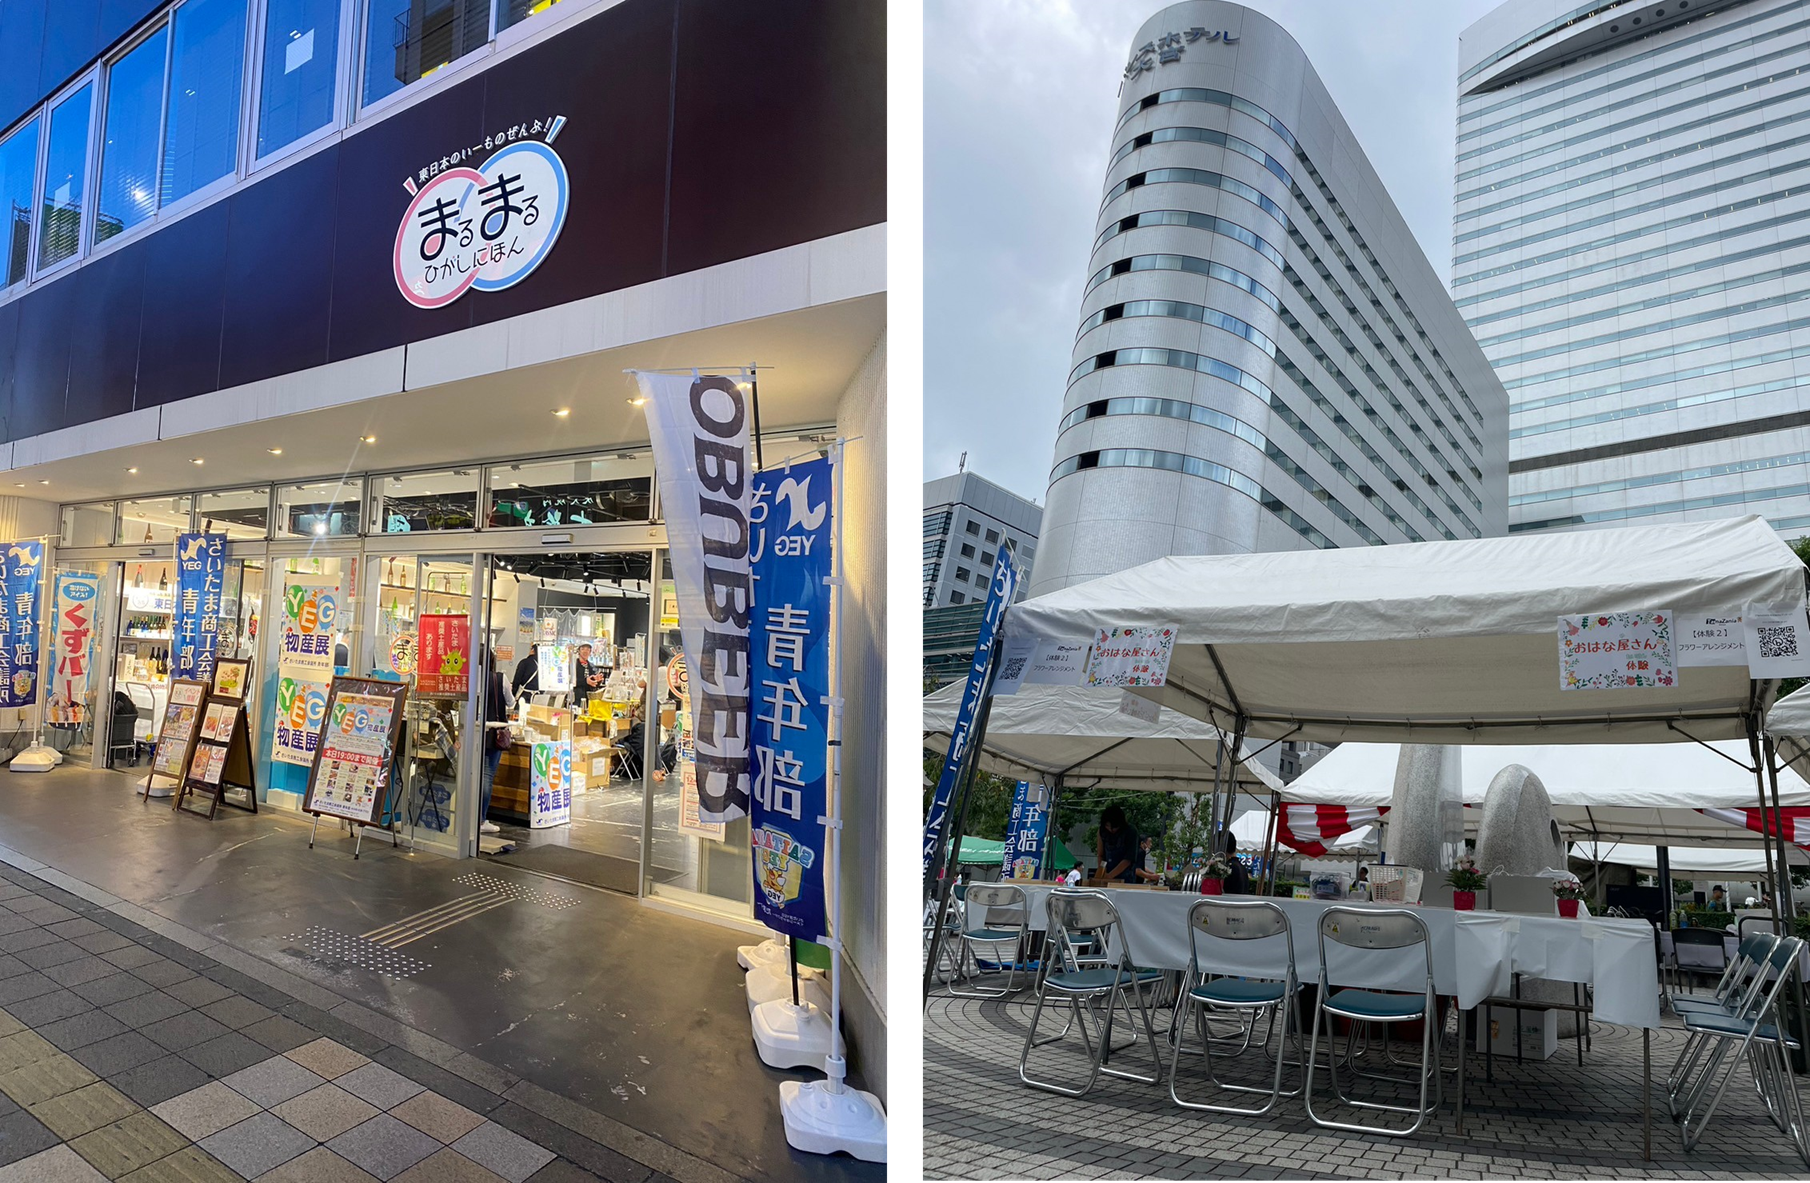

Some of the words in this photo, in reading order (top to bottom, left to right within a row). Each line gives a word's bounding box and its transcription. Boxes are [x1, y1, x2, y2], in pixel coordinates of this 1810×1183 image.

[417, 173, 539, 262] まるまる
[424, 236, 525, 284] ひがしにほん
[182, 561, 202, 570] YEG
[288, 591, 335, 628] YEG
[180, 588, 200, 670] 青年部
[451, 619, 459, 648] さいたま
[58, 602, 90, 703] くずバー
[285, 632, 330, 656] 物産展
[425, 633, 433, 661] あります
[1100, 647, 1160, 658] おはな屋さん
[1574, 638, 1658, 654] おはな屋さん
[1679, 642, 1745, 652] フラワーアレンジメント
[1626, 660, 1649, 671] 体験
[438, 676, 467, 684] さいたま
[281, 685, 326, 724] YEG
[334, 708, 368, 730] YEG
[325, 750, 380, 766] 本日19:00まで開催
